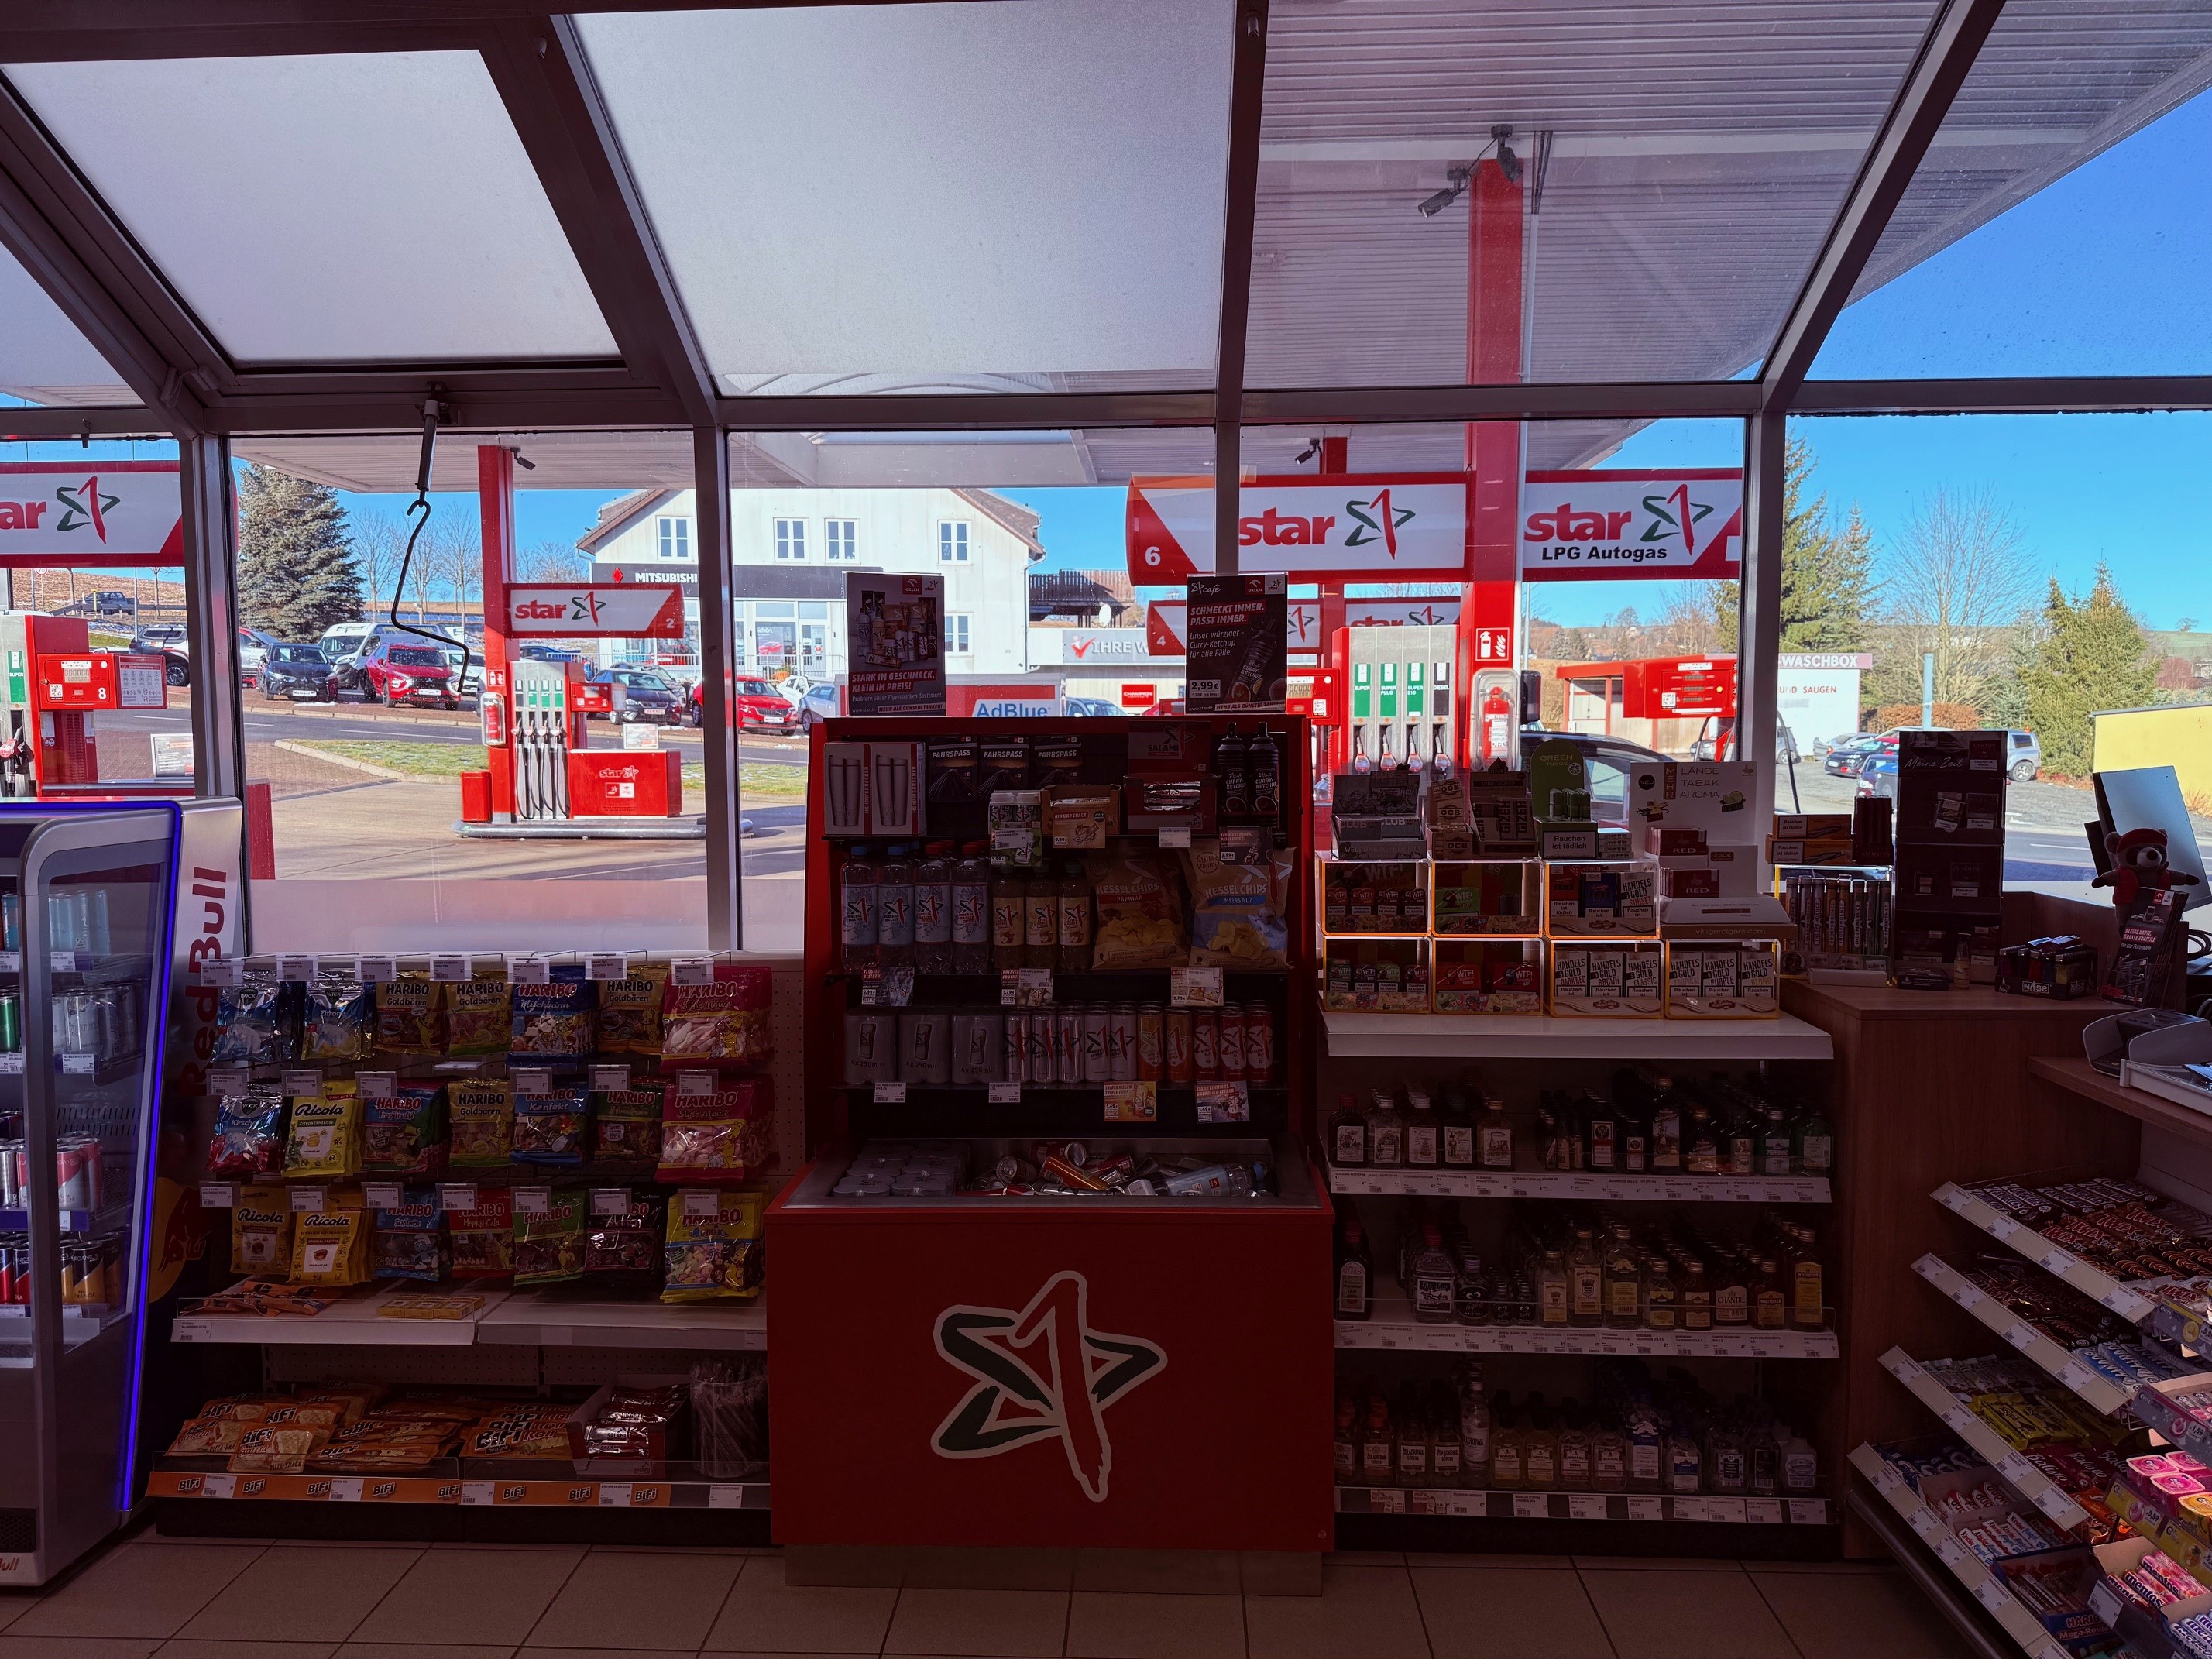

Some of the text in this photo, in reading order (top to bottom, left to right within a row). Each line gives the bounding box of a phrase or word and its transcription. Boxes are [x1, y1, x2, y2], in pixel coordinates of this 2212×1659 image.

[1238, 507, 1335, 547] star
[1523, 502, 1632, 542] star
[1145, 546, 1161, 566] 6
[1541, 545, 1668, 562] LPG Autogas
[634, 572, 698, 583] MITSUBISHI
[1203, 584, 1221, 596] café
[514, 599, 567, 620] star
[1190, 602, 1264, 616] SCHMECKT IMMER.
[666, 618, 675, 629] 2
[1190, 613, 1247, 626] PASST IMMER.
[1156, 635, 1166, 646] 4
[1210, 629, 1239, 640] würziger
[1092, 641, 1132, 654] IHRE
[1190, 639, 1236, 650] Curry-Ketchup
[1190, 650, 1200, 658] für
[1214, 648, 1232, 657] Fälle.
[1240, 670, 1262, 679] KETCHUP
[1242, 665, 1260, 673] CURRY-
[852, 671, 935, 682] STARK IM GESCHMACK,
[98, 687, 107, 699] 8
[852, 682, 912, 693] KLEIN IM PREIS!
[1803, 685, 1837, 694] SAUGEN
[932, 749, 971, 759] FAHRSPASS
[1038, 750, 1077, 758] FAHRSPASS
[1904, 756, 1965, 769] Meine Zeit
[599, 768, 623, 778] star
[1681, 765, 1719, 775] LÄNGE
[1441, 783, 1460, 792] OCB
[1665, 768, 1675, 799] MEHR
[1680, 790, 1719, 799] AROMA
[1381, 818, 1406, 826] CLUB
[1500, 800, 1511, 834] GIZEH
[1517, 800, 1527, 834] GIZEH
[1097, 883, 1160, 895] KESSEL CHIPS
[1623, 878, 1652, 891] HANDELS
[1206, 884, 1267, 898] KESSEL CHIPS
[1456, 891, 1473, 900] WTF!
[1630, 889, 1647, 898] GOLD
[189, 867, 227, 973] Bull
[1705, 959, 1734, 970] HANDELS
[1516, 970, 1533, 980] WTF!
[1712, 969, 1730, 978] GOLD
[1711, 976, 1734, 986] PURPLE
[386, 982, 430, 997] HARIBO
[456, 981, 504, 995] HARIBO
[518, 981, 577, 998] HARIBO
[386, 997, 427, 1006] Goldbären
[459, 995, 501, 1005] Goldbären
[183, 985, 222, 1097] Red
[375, 1097, 422, 1110] HARIBO
[607, 1091, 655, 1105] HARIBO
[675, 1091, 737, 1108] HARIBO
[294, 1103, 344, 1116] Ricola
[528, 1101, 569, 1112] Konfekt
[704, 1108, 731, 1118] Mäuse
[238, 1208, 284, 1223] Ricola
[304, 1214, 350, 1227] Ricola
[2126, 1207, 2167, 1228] TWIX
[462, 1218, 500, 1228] Happy Cola
[2097, 1213, 2136, 1235] TWIX
[2084, 1351, 2131, 1377] BOUNTY
[242, 1428, 273, 1444] BiFi
[2025, 1453, 2067, 1482] Balisto
[2063, 1452, 2107, 1478] Balisto
[178, 1478, 201, 1490] BiFi
[503, 1486, 526, 1498] BiFi
[635, 1488, 657, 1500] BiFi
[2142, 1560, 2179, 1595] mentos
[2124, 1572, 2163, 1609] mentos
